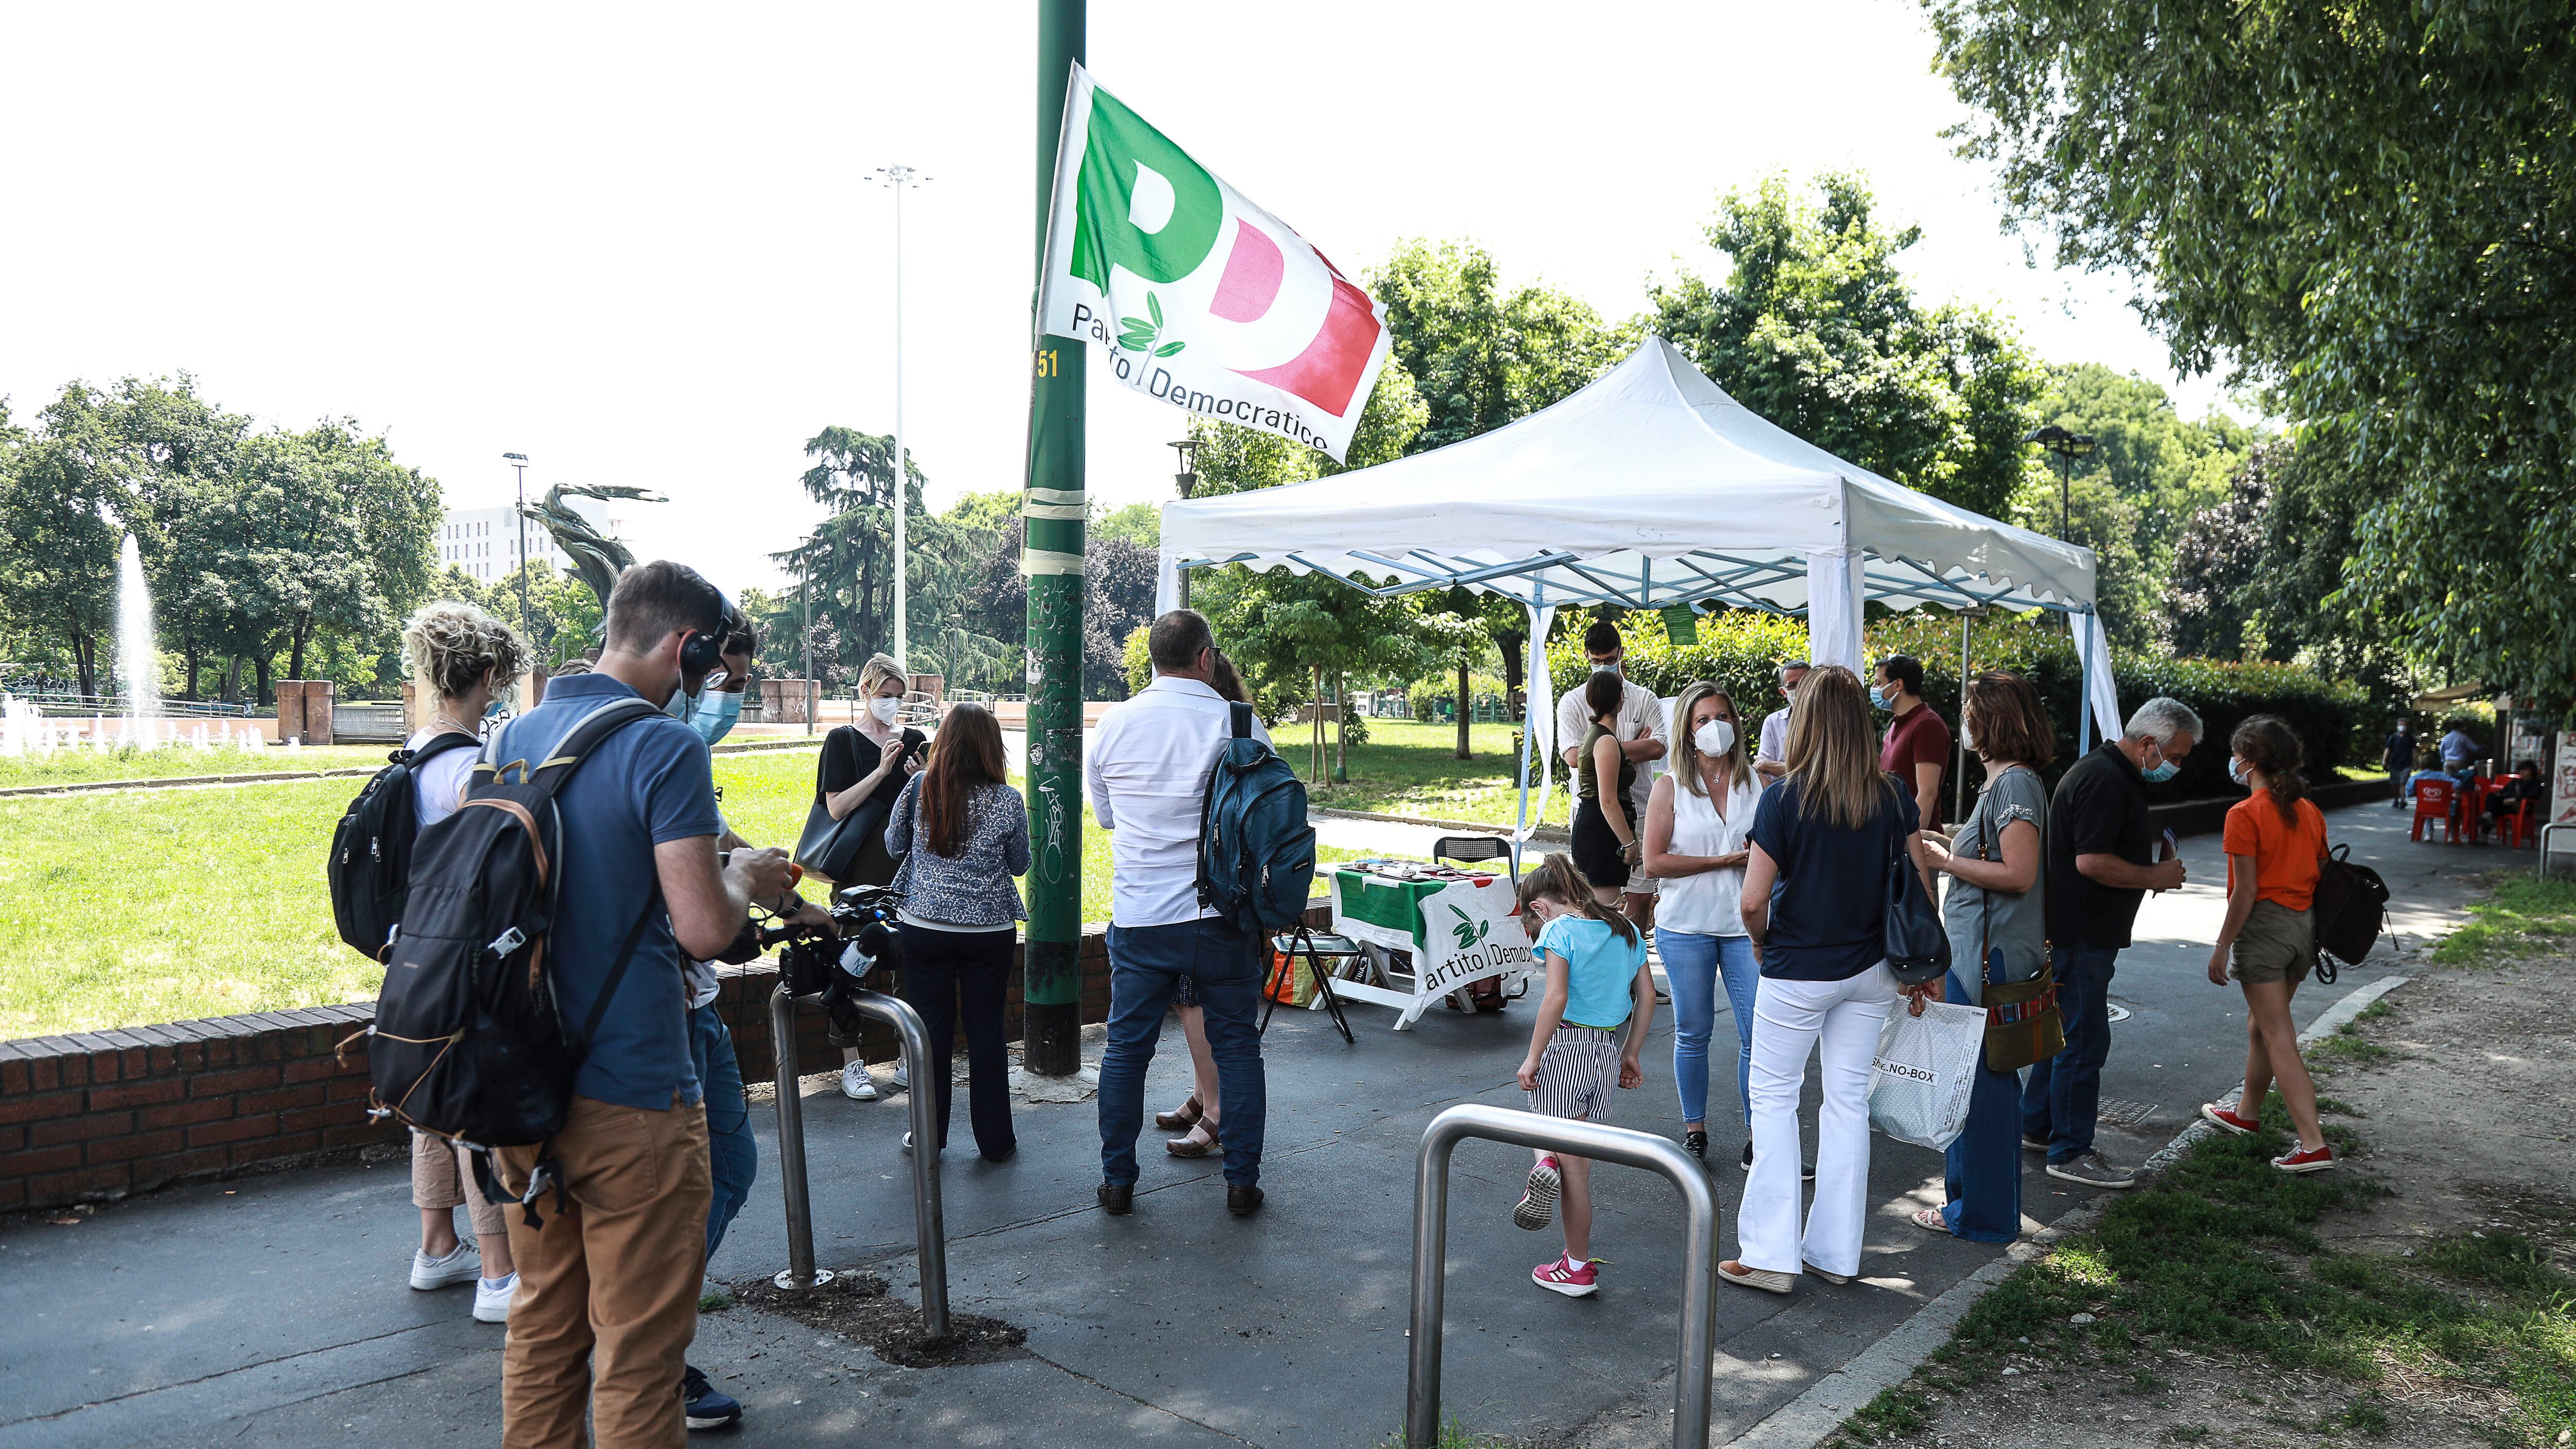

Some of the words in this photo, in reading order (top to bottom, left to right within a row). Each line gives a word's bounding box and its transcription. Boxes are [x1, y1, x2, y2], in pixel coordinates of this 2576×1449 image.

[1150, 367, 1328, 449] Democratico
[1354, 967, 1364, 983] TINA
[1425, 953, 1484, 991] artito
